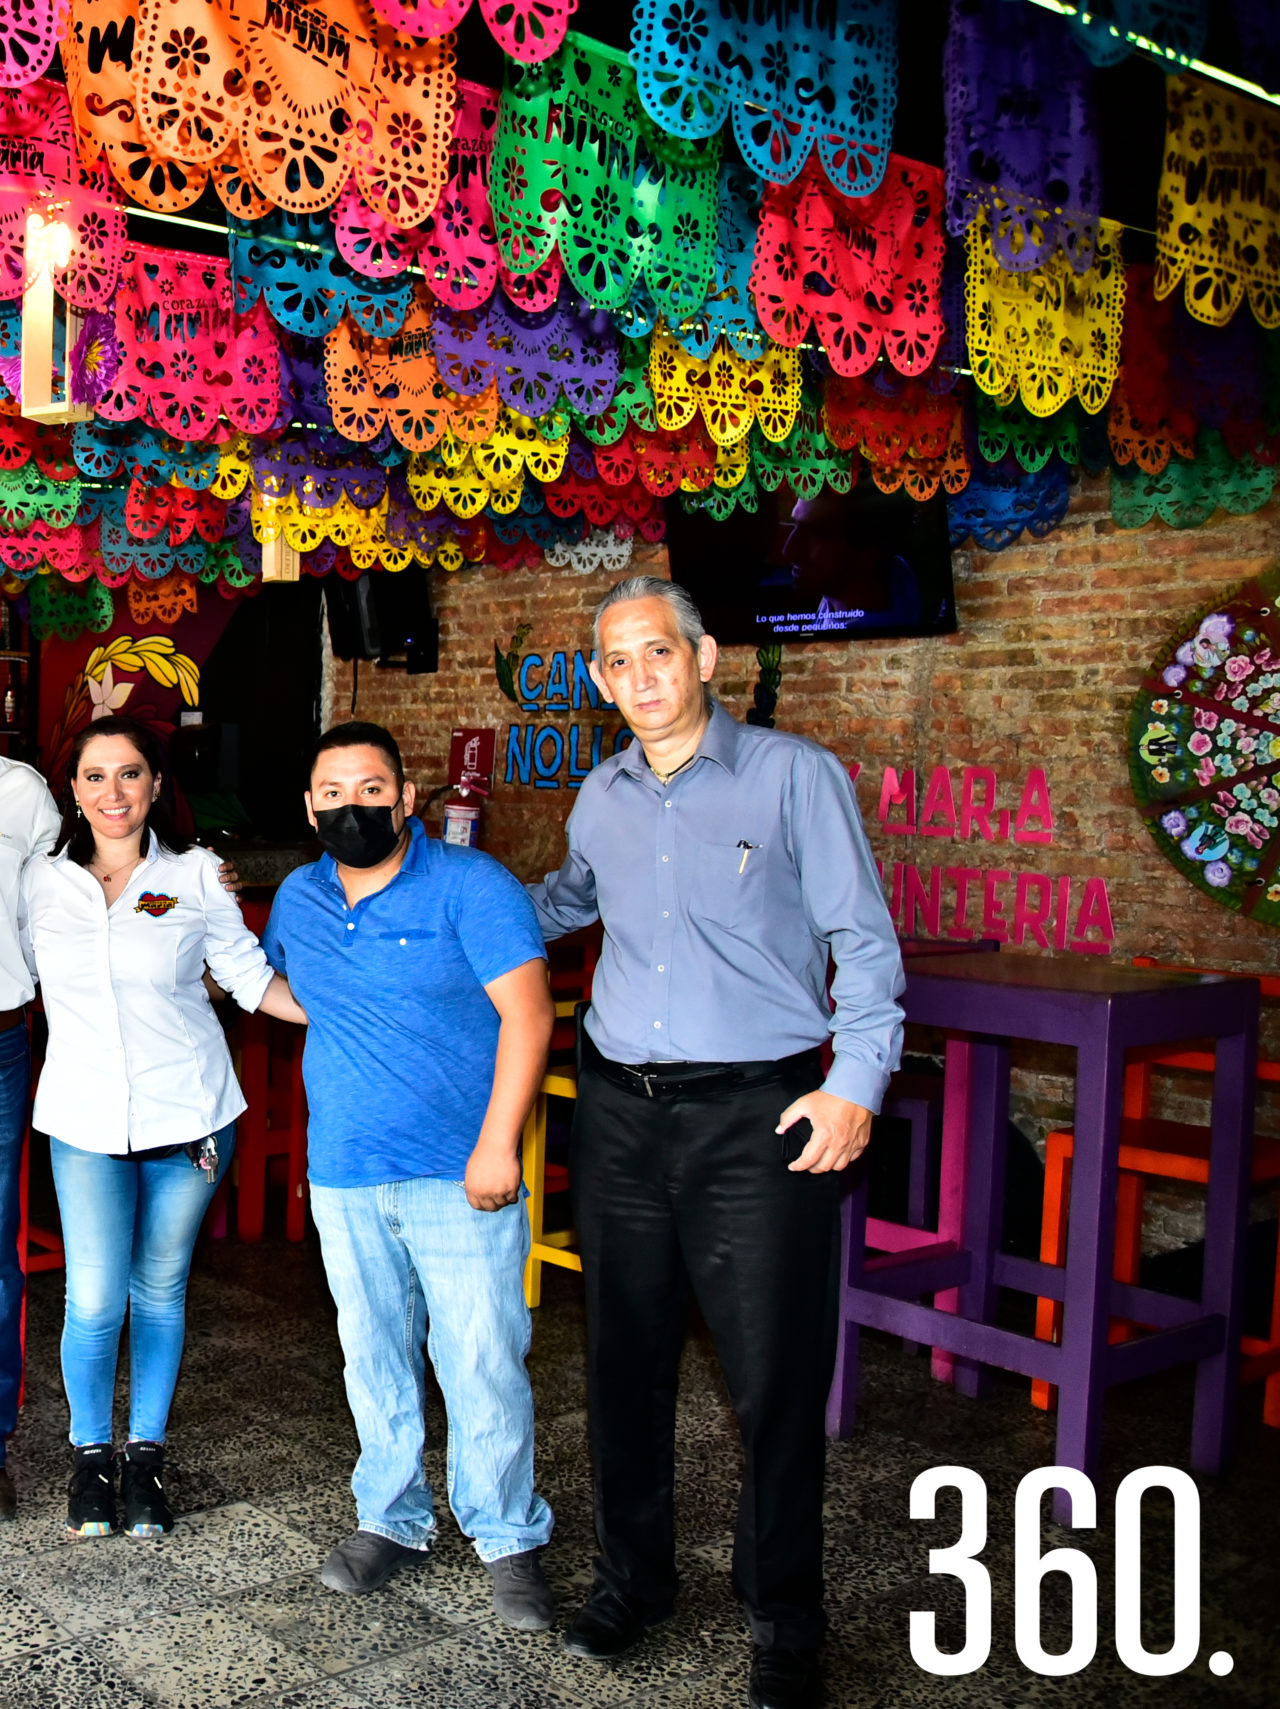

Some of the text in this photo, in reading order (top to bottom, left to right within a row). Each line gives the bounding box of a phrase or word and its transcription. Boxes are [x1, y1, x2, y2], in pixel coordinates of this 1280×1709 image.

[755, 608, 865, 623] Lo que hemos construido
[773, 623, 800, 633] desde
[877, 764, 1054, 843] MARIA
